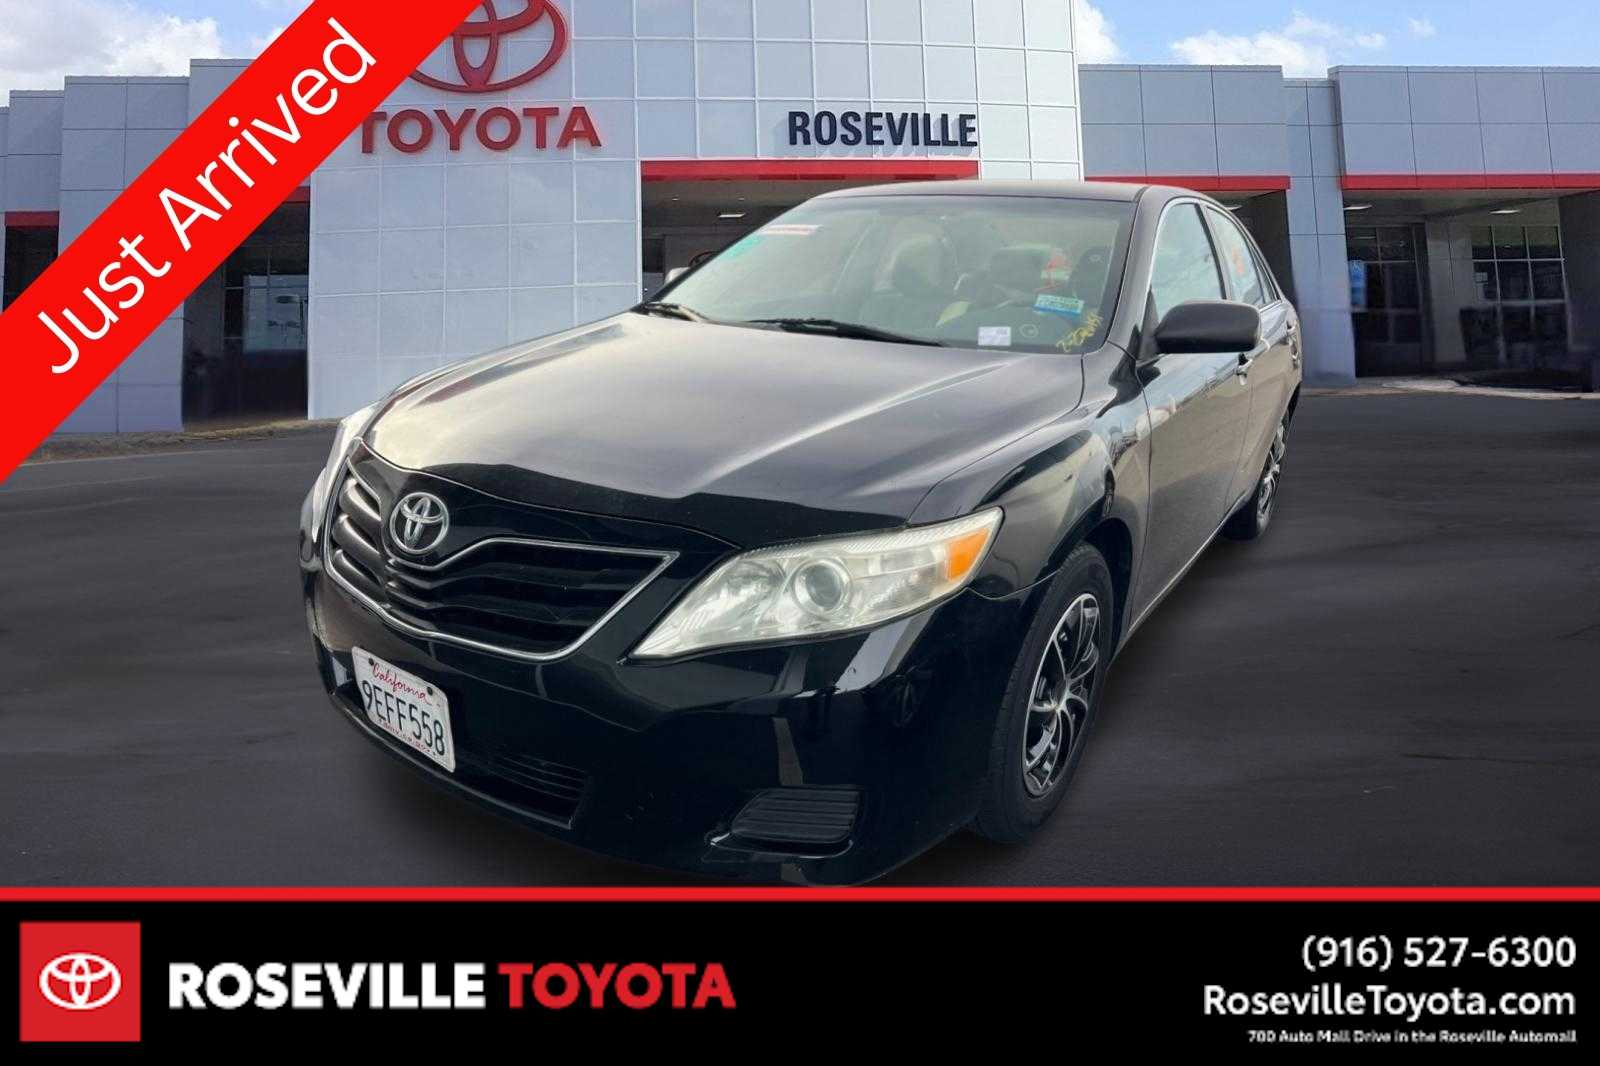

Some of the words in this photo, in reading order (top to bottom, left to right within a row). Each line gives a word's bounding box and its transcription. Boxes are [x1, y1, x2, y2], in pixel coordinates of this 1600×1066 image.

[361, 106, 602, 153] TOYOTA
[788, 111, 978, 147] ROSEVILLE
[372, 662, 432, 705] California
[362, 680, 445, 756] 9EFF558
